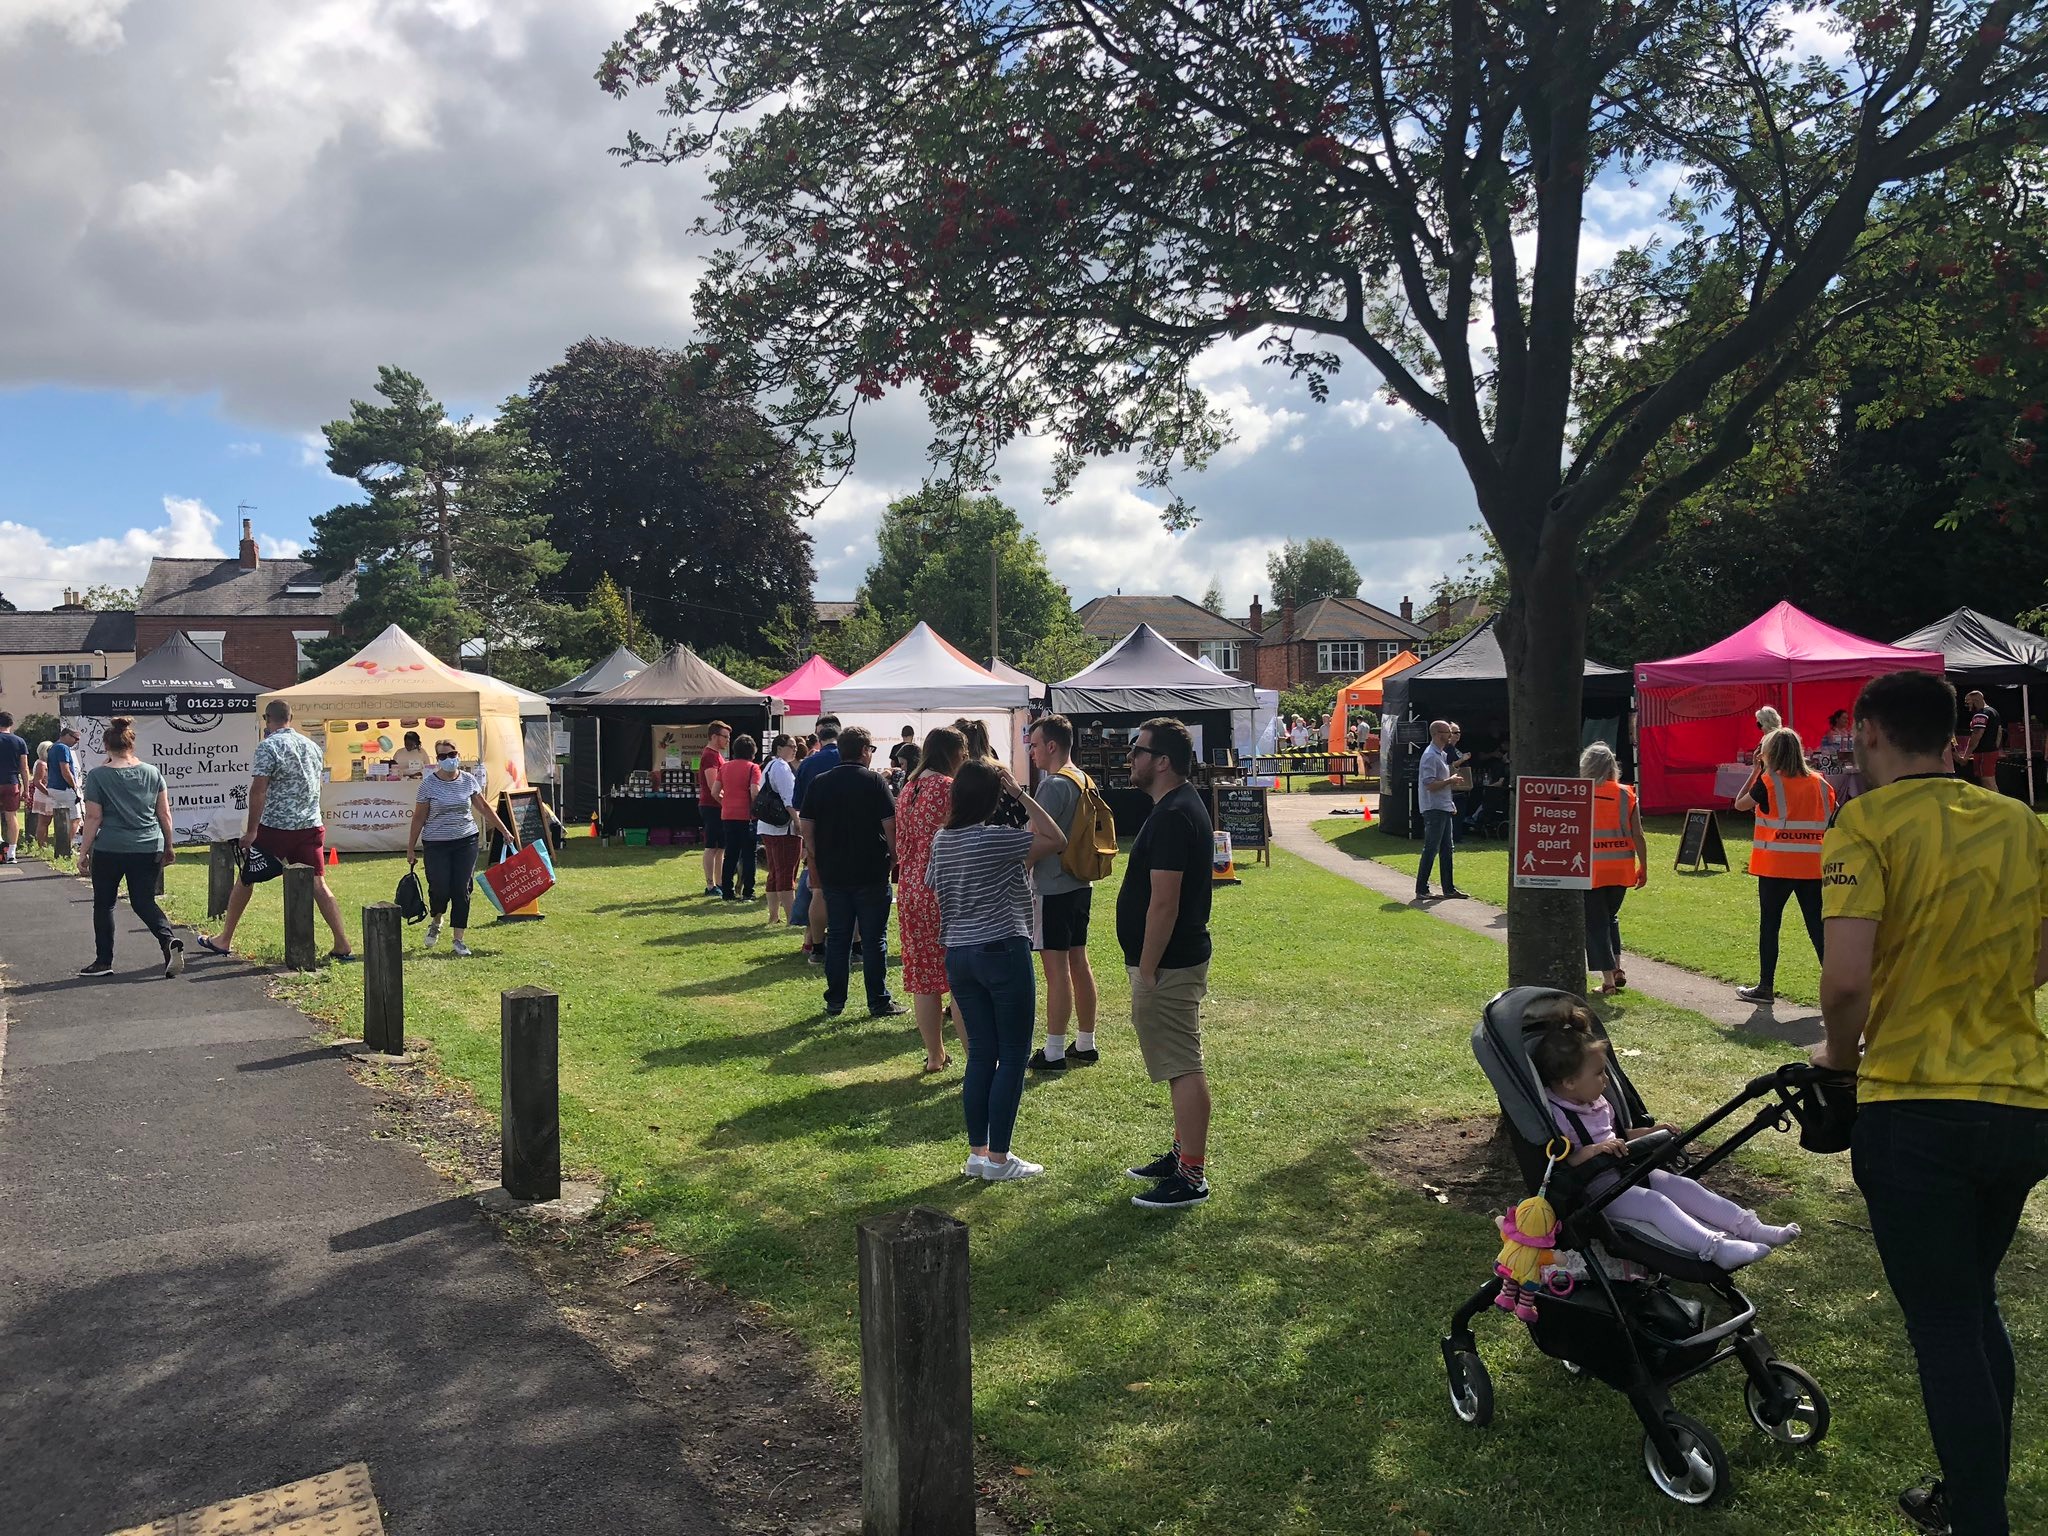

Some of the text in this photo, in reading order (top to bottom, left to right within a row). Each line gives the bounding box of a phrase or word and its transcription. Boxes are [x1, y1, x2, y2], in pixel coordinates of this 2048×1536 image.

[111, 700, 130, 708] NFU
[131, 700, 163, 708] Mutual
[187, 698, 225, 709] 01623
[227, 699, 249, 708] 870
[314, 700, 382, 711] handcrafted
[152, 742, 239, 758] Ruddington
[154, 760, 249, 779] llage Market
[1524, 782, 1587, 796] COVID-19
[178, 793, 226, 806] Mutual
[320, 809, 414, 819] RENCH MACARO
[1533, 806, 1577, 819] Please
[1529, 822, 1579, 836] stay 2m
[1776, 832, 1824, 840] VOLUNTE
[1537, 839, 1571, 852] apart
[510, 864, 527, 879] only
[500, 866, 542, 895] went in for
[505, 891, 519, 903] one
